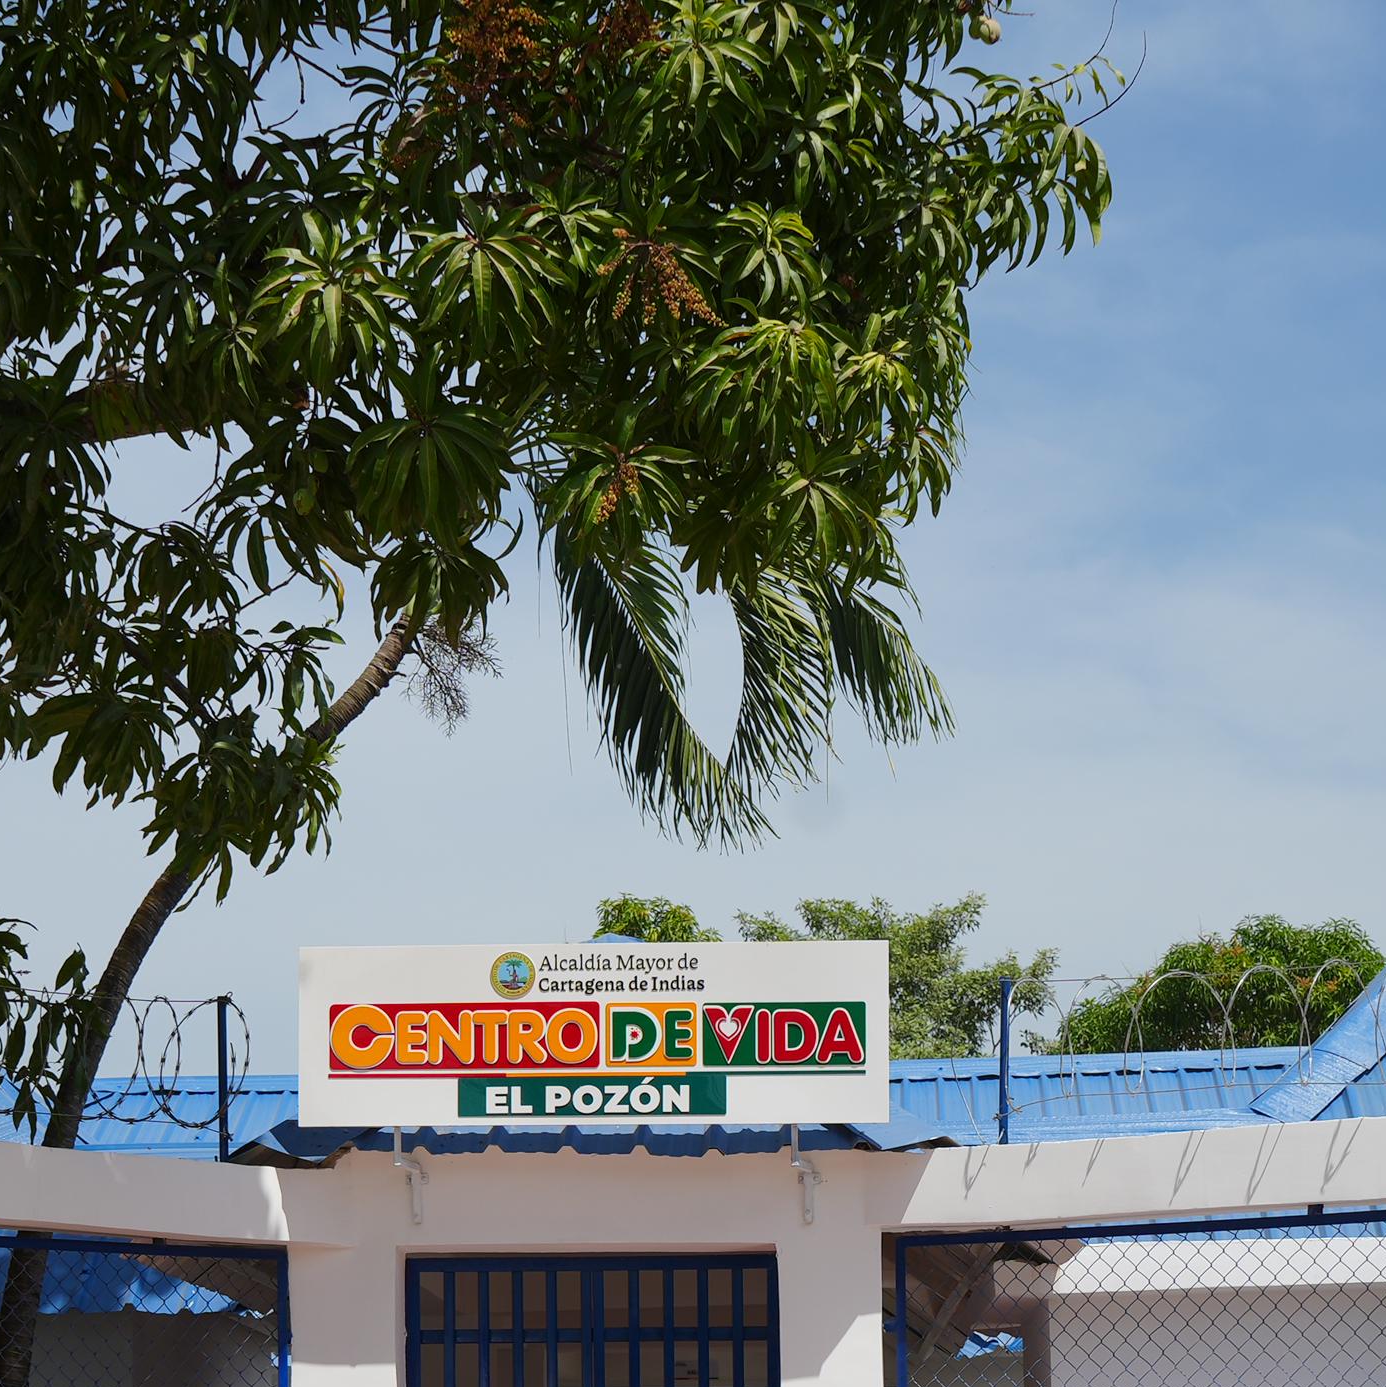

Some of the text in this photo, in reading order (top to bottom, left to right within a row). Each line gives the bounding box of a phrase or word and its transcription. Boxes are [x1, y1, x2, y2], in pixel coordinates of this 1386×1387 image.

[538, 952, 699, 974] Alcaldía Mayor de
[538, 975, 705, 996] Cartagena de Indias
[330, 1004, 865, 1069] CENTRO DE VIDA
[485, 1077, 690, 1115] EL POZÓN
